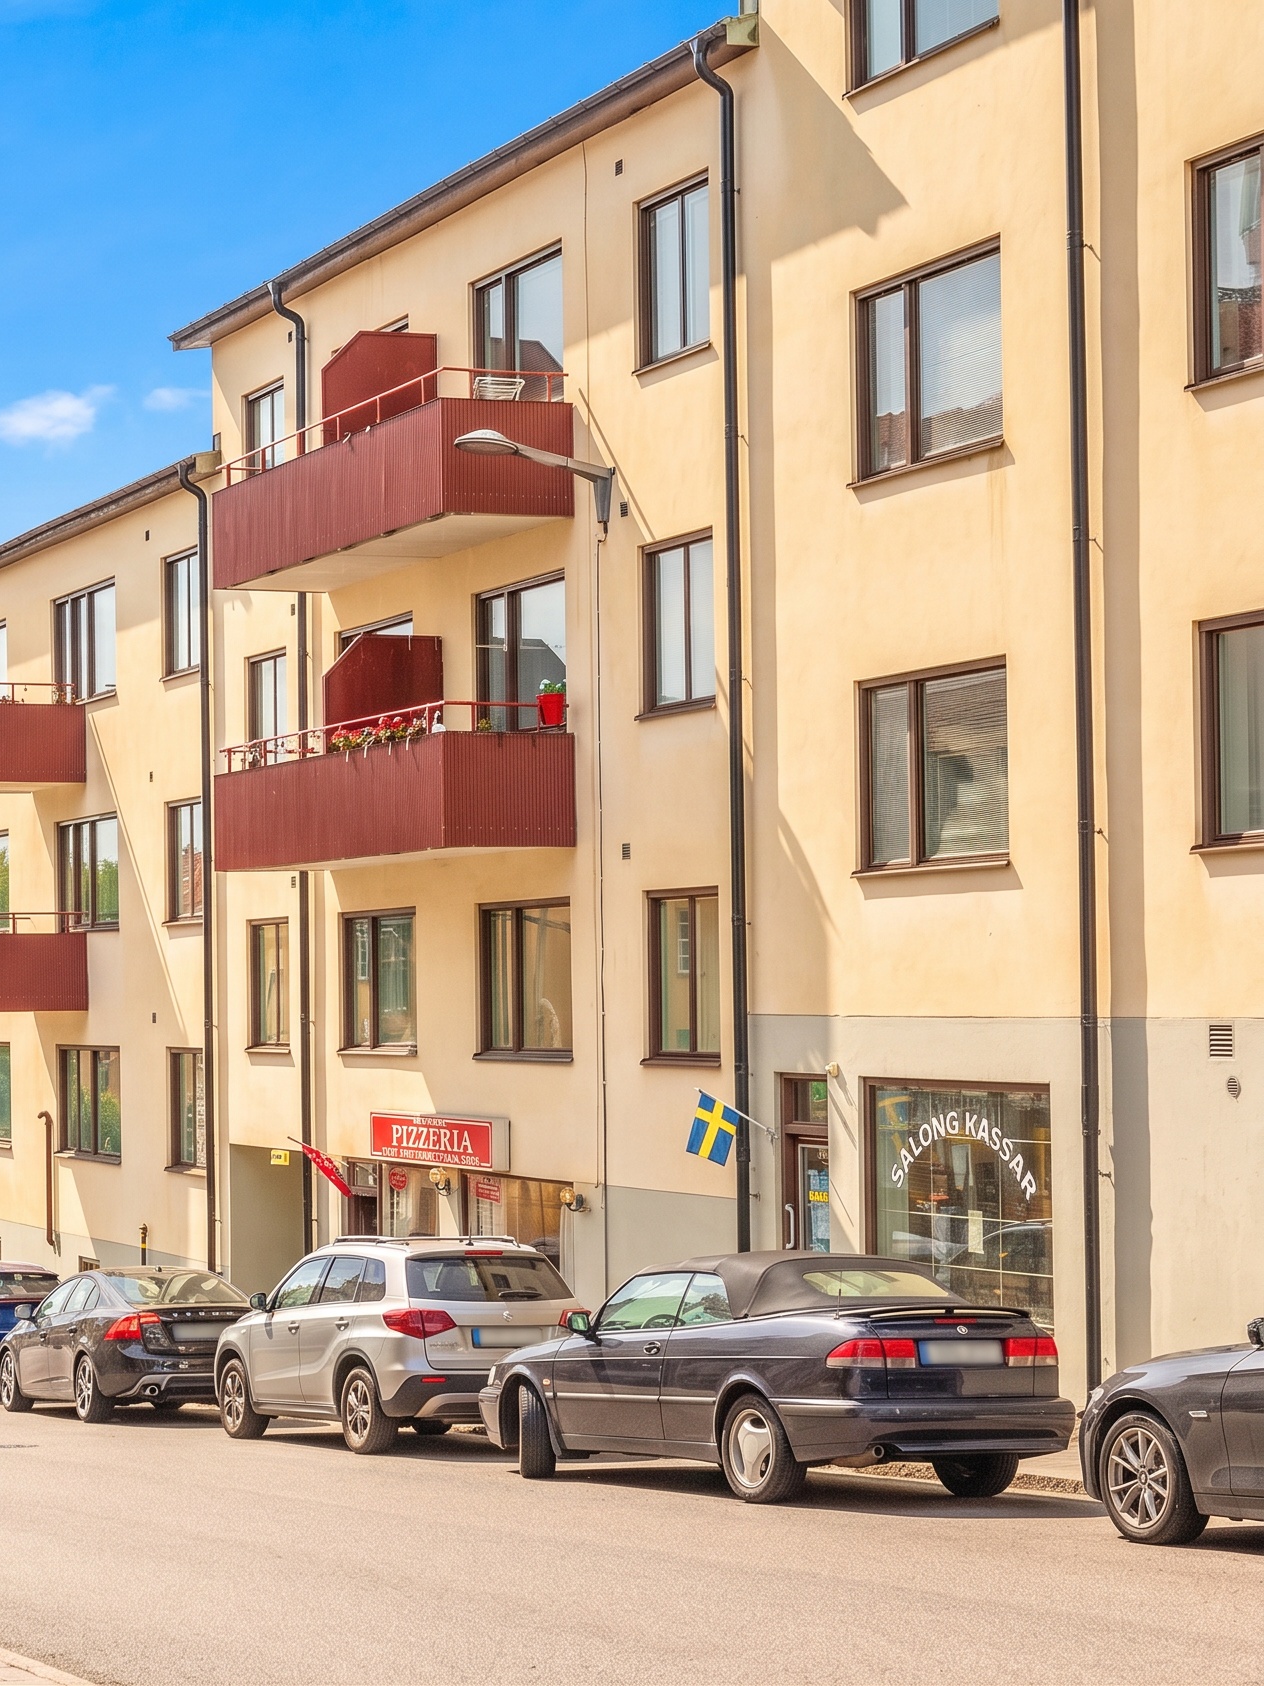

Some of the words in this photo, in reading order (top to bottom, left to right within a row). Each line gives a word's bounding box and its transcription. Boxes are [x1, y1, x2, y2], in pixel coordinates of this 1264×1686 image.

[391, 1124, 474, 1154] PIZZERIA
[891, 1111, 959, 1188] SALONG
[965, 1112, 1037, 1201] KASSAR
